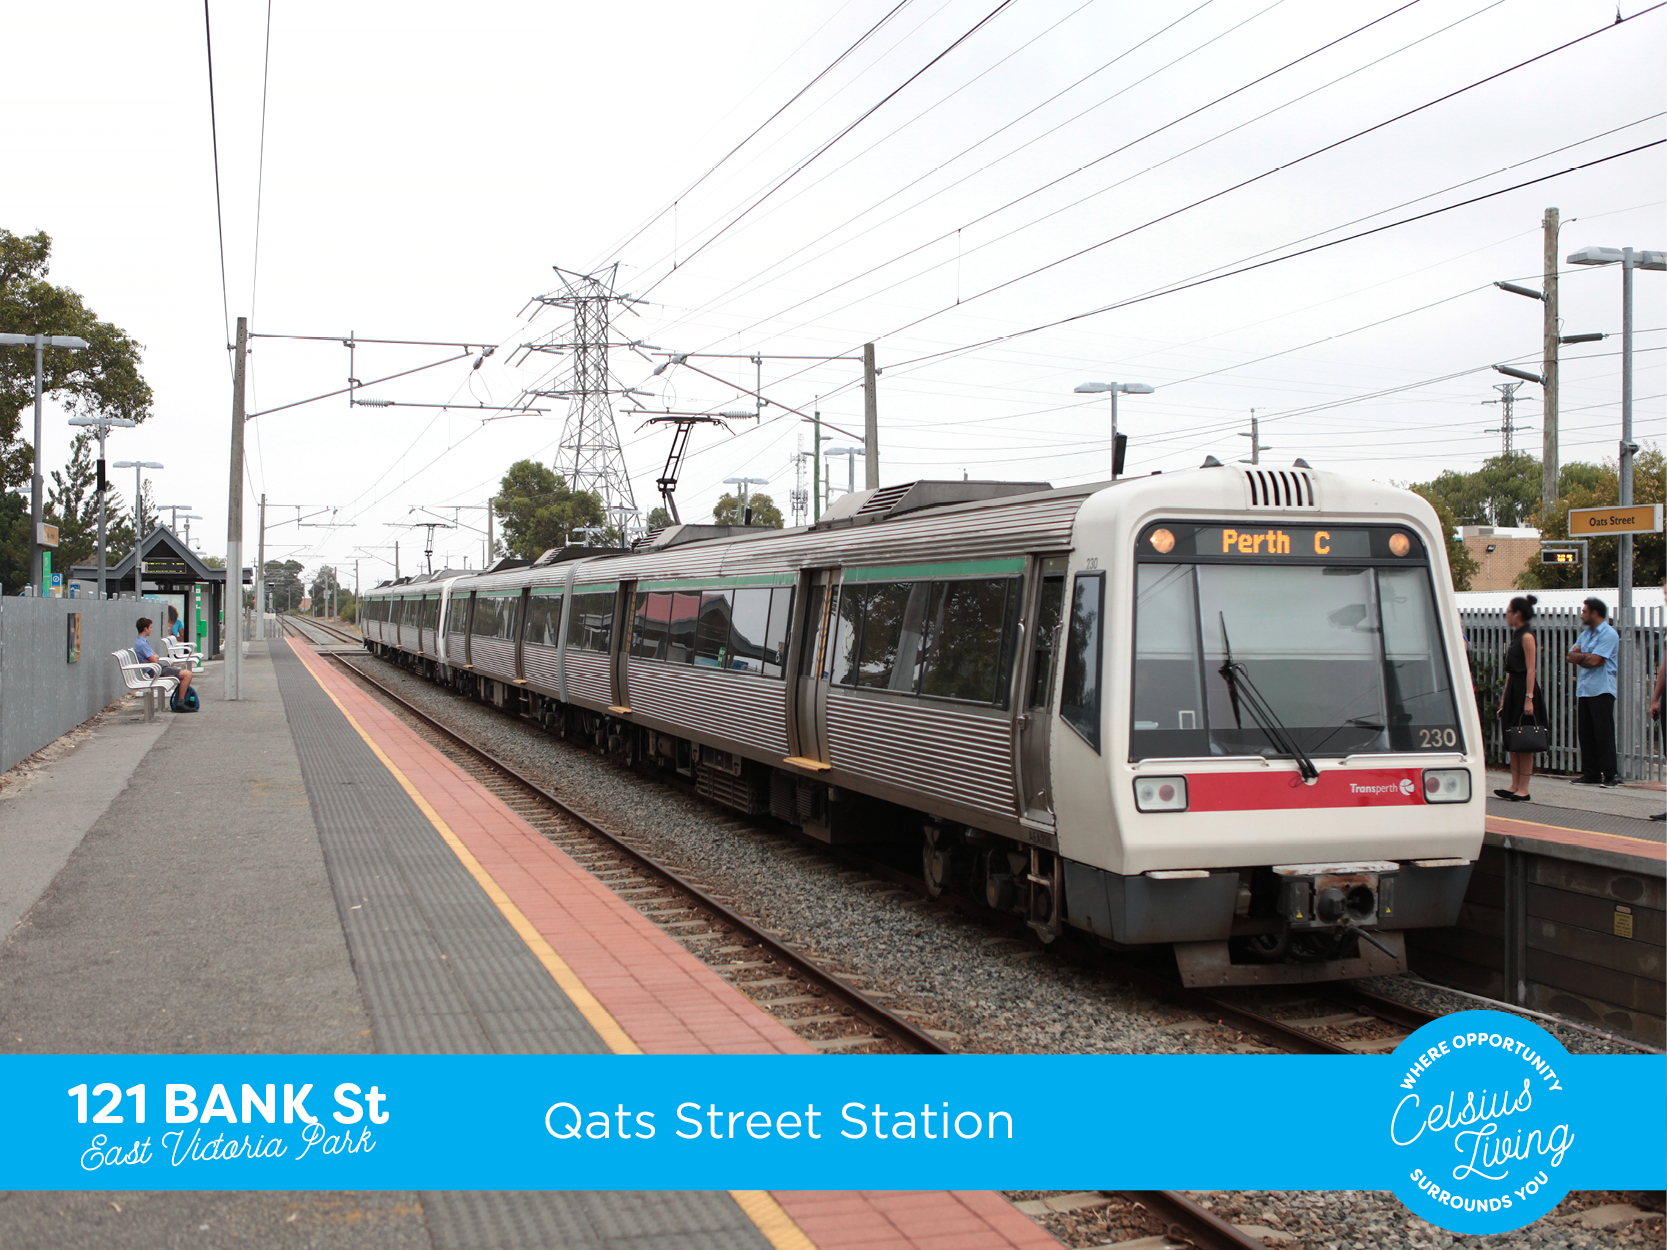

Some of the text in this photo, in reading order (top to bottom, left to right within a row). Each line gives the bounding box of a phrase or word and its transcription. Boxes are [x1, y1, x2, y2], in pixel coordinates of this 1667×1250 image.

[1589, 515, 1636, 527] Oats Street
[1222, 529, 1331, 555] Perth C
[1085, 557, 1099, 570] 230
[1419, 728, 1457, 748] 230
[1349, 783, 1398, 795] Transperth
